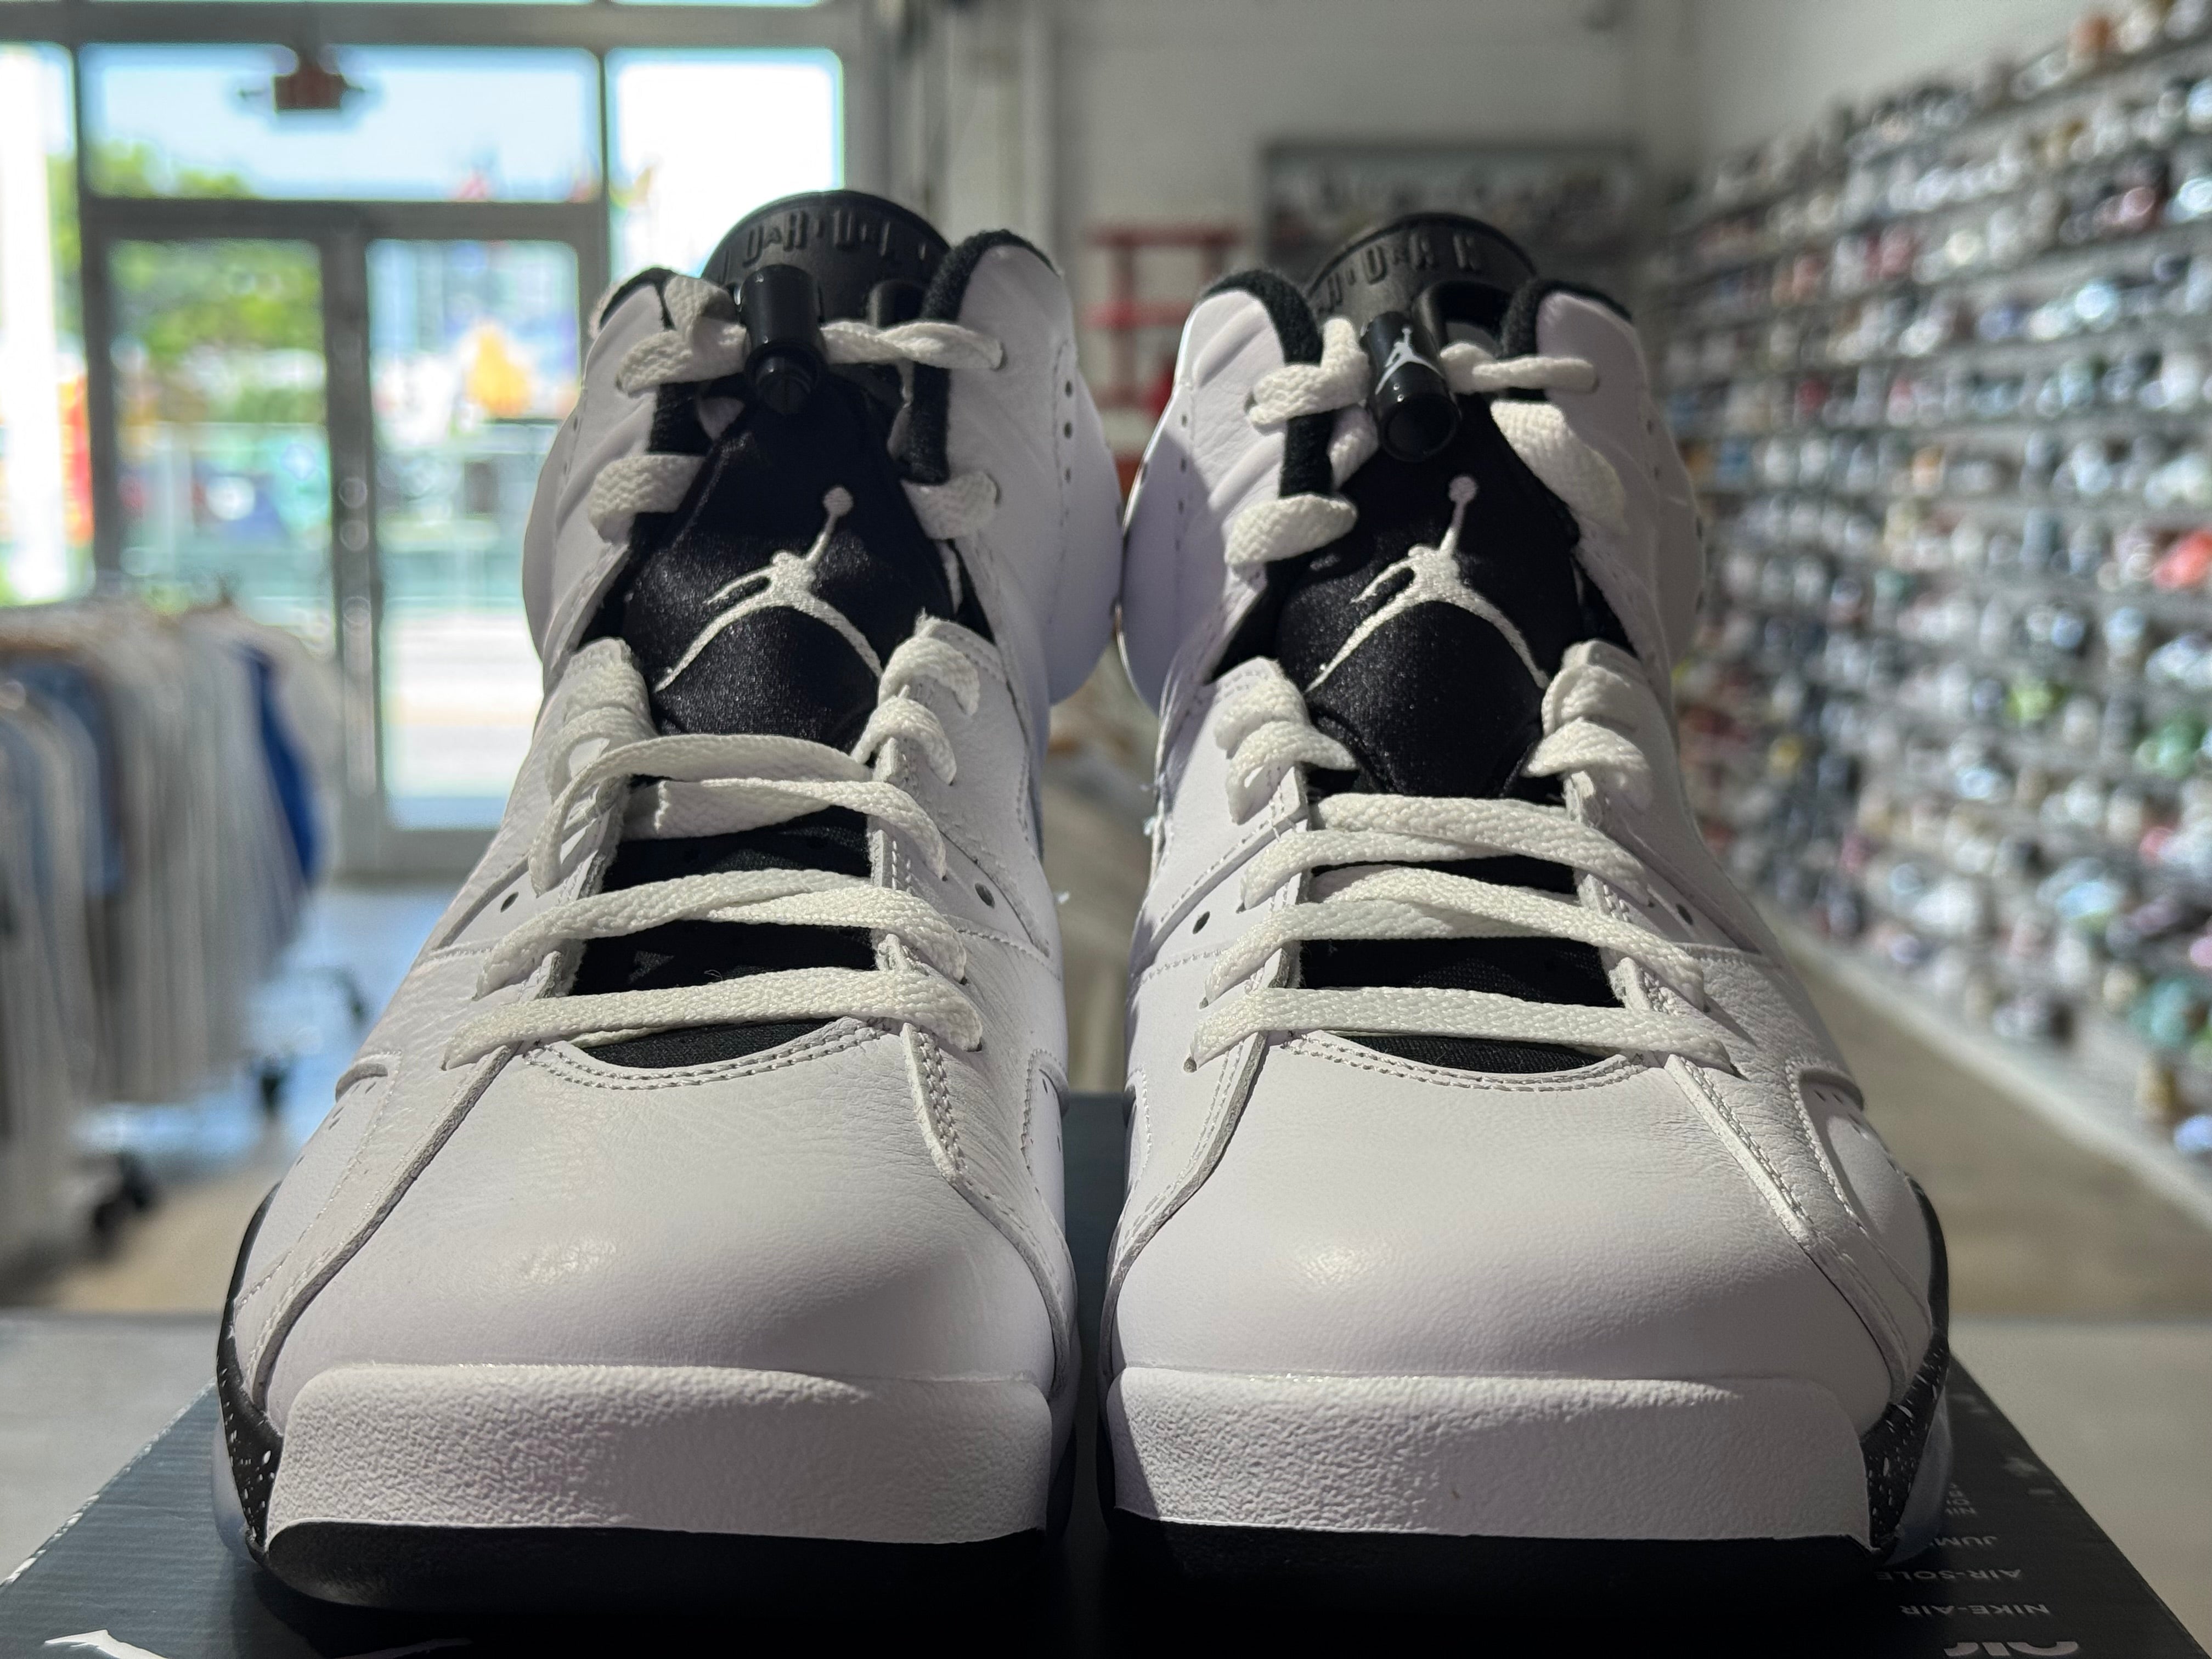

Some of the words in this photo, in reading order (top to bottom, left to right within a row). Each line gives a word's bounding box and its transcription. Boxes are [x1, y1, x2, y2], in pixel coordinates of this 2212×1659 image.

[1931, 1536, 1999, 1548] JUM
[1875, 1568, 2022, 1581] AIR-SOLE
[1899, 1604, 2051, 1616] NIKE-AIR
